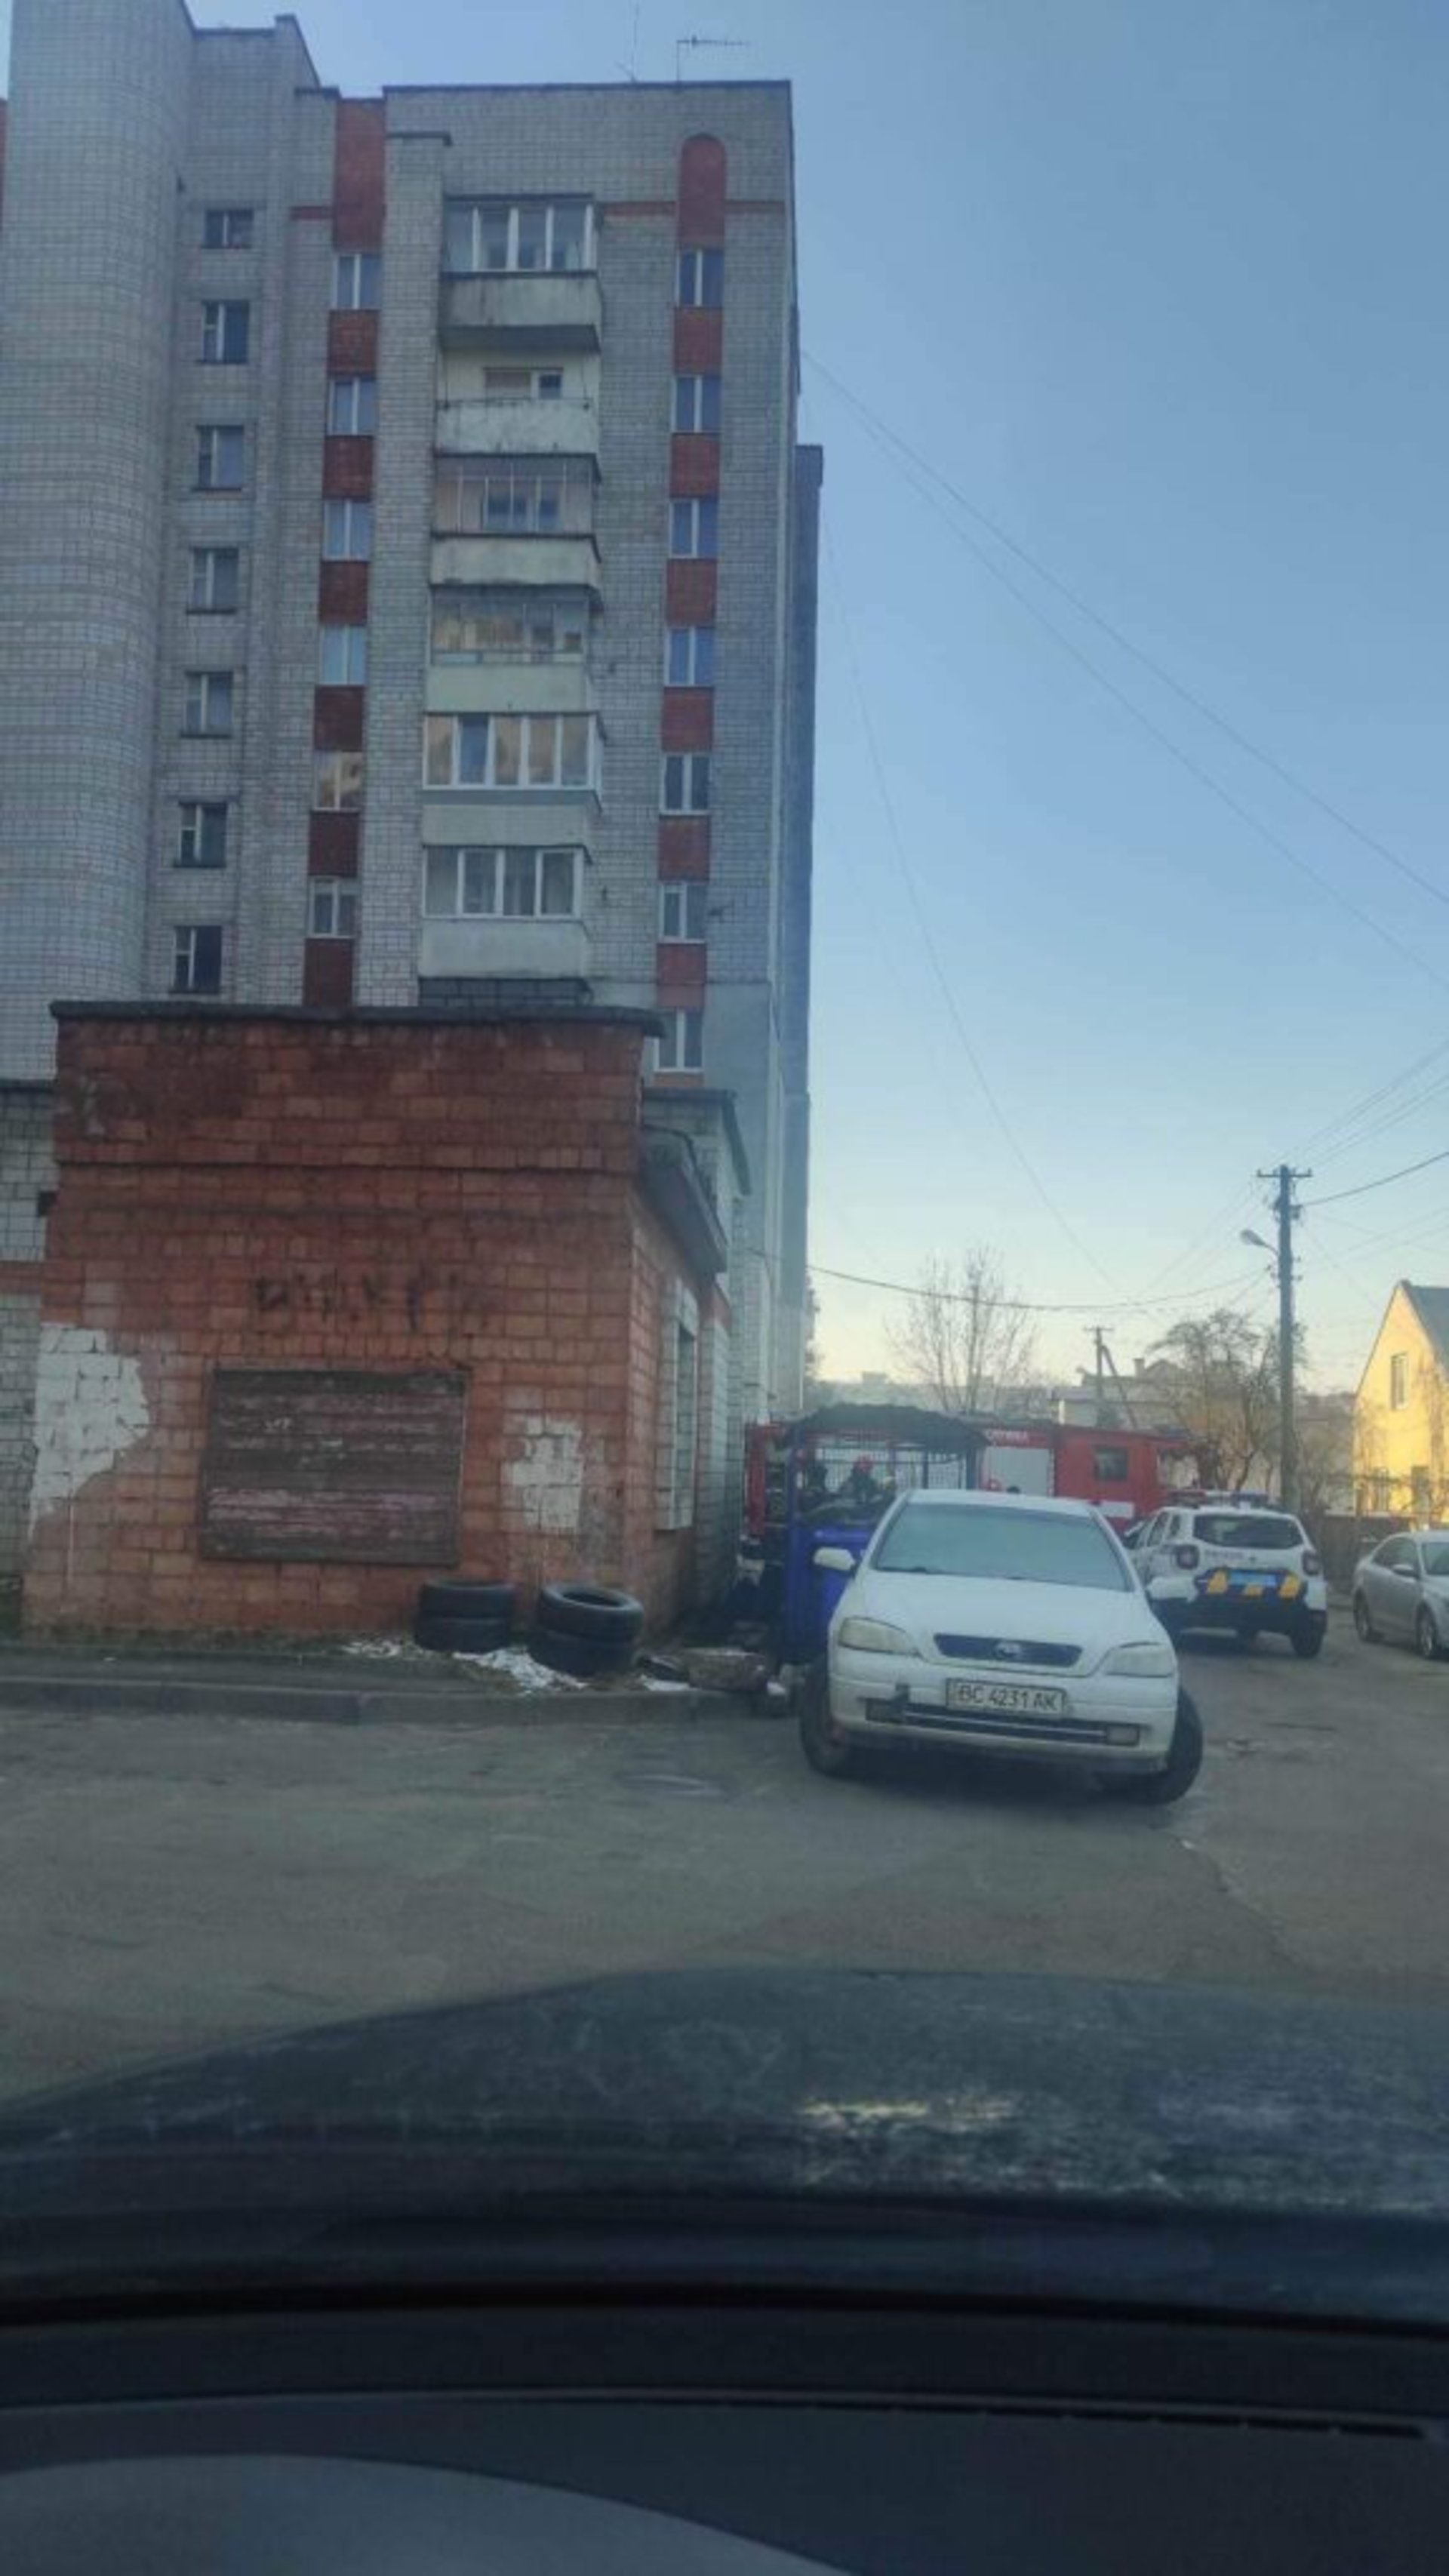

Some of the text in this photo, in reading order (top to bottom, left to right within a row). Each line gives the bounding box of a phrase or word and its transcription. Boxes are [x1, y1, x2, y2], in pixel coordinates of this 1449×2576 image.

[958, 1685, 1058, 1711] BC 4231 AK
